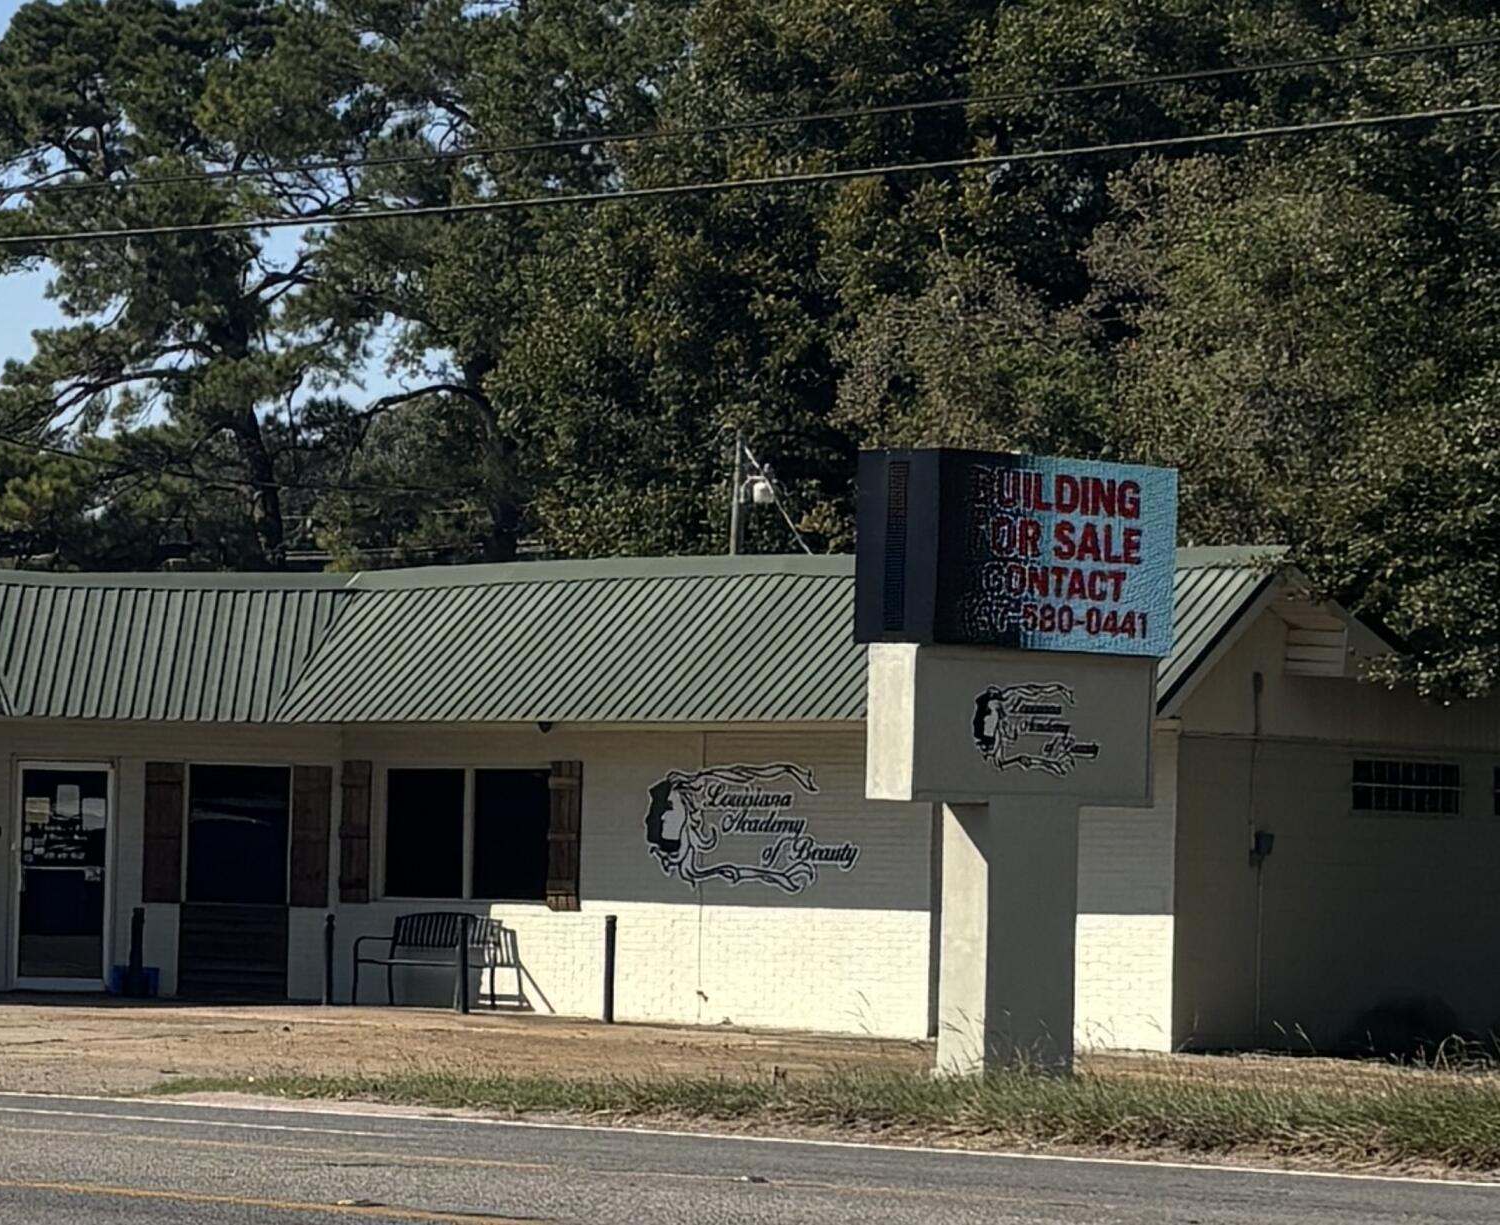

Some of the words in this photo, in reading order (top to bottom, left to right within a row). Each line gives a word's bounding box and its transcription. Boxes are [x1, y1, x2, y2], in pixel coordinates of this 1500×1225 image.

[973, 514, 1042, 558] OR
[1053, 521, 1143, 565] SALE
[982, 561, 1127, 602] CONTACT
[703, 782, 792, 808] Louisiana
[722, 810, 806, 837] Academy
[762, 837, 793, 867] of
[789, 836, 859, 868] Beauty
